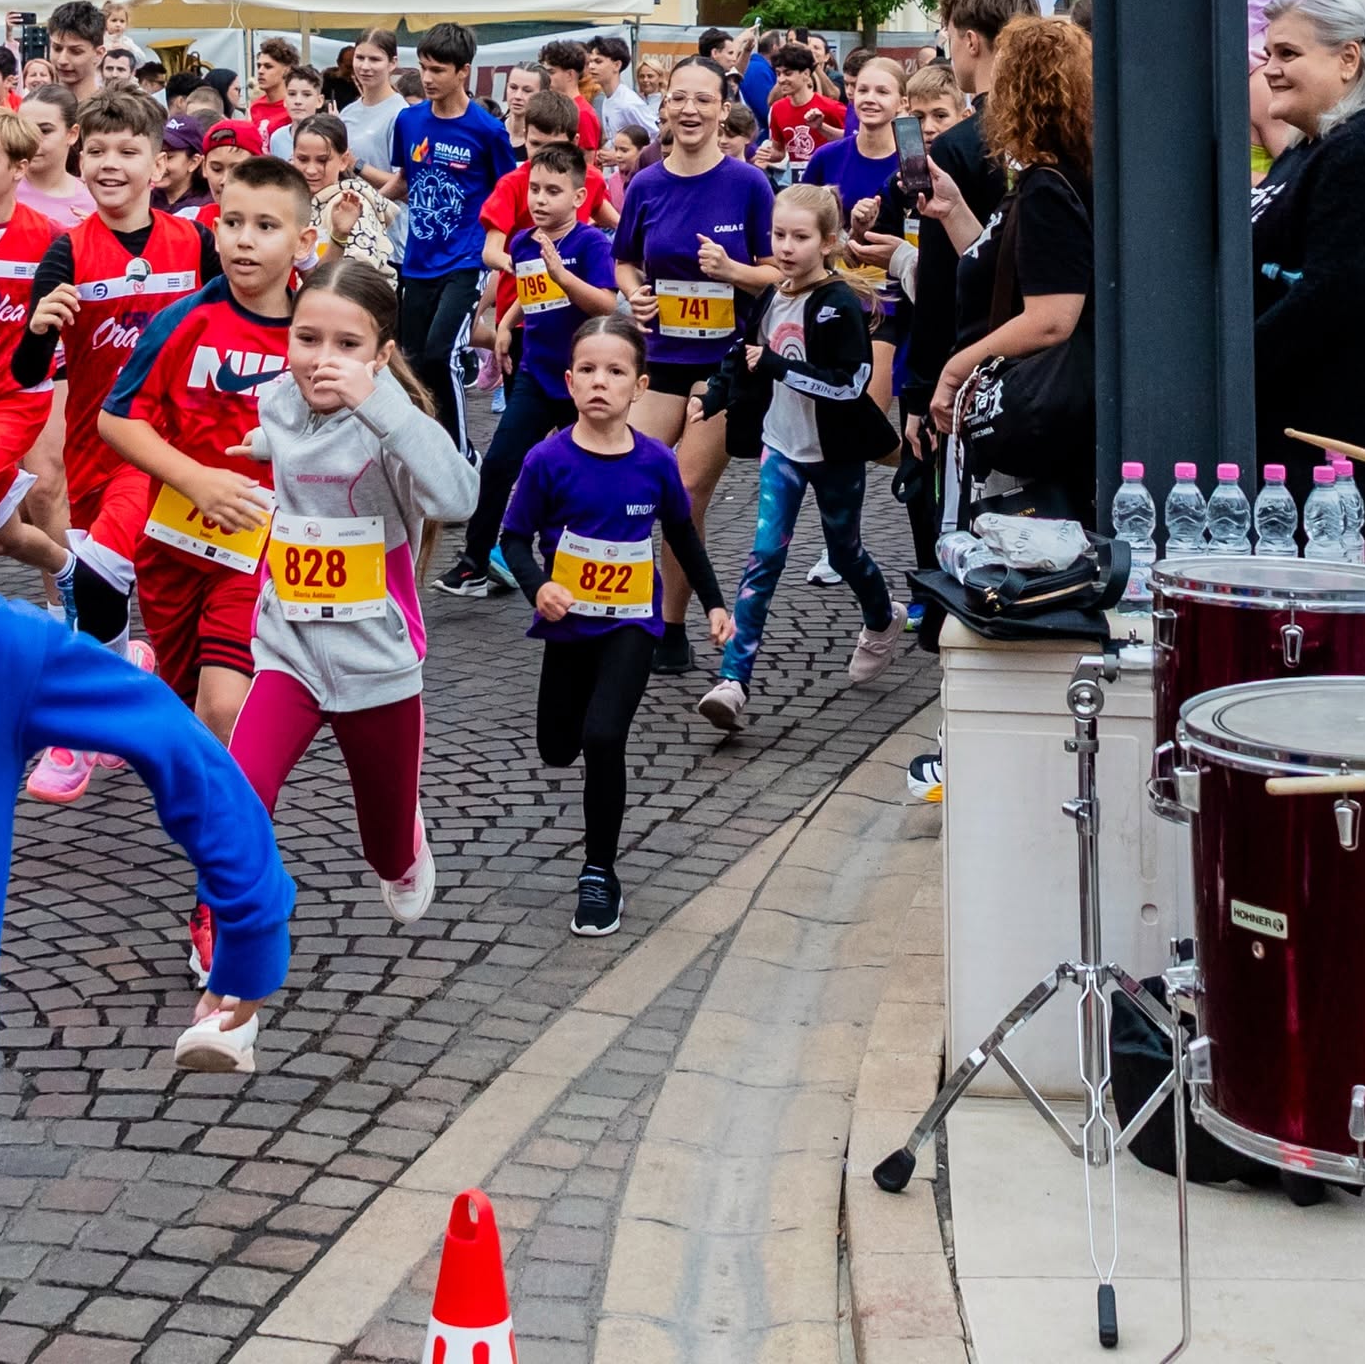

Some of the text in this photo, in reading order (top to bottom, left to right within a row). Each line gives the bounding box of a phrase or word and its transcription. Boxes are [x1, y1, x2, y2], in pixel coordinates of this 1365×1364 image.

[435, 142, 471, 158] SINAIA
[714, 224, 738, 233] CARLA
[521, 274, 547, 297] 796
[678, 298, 709, 320] 741
[92, 316, 141, 350] Ora
[810, 381, 832, 395] NIKE
[285, 547, 347, 588] 828
[580, 561, 633, 594] 822
[1233, 907, 1273, 928] HOHNER
